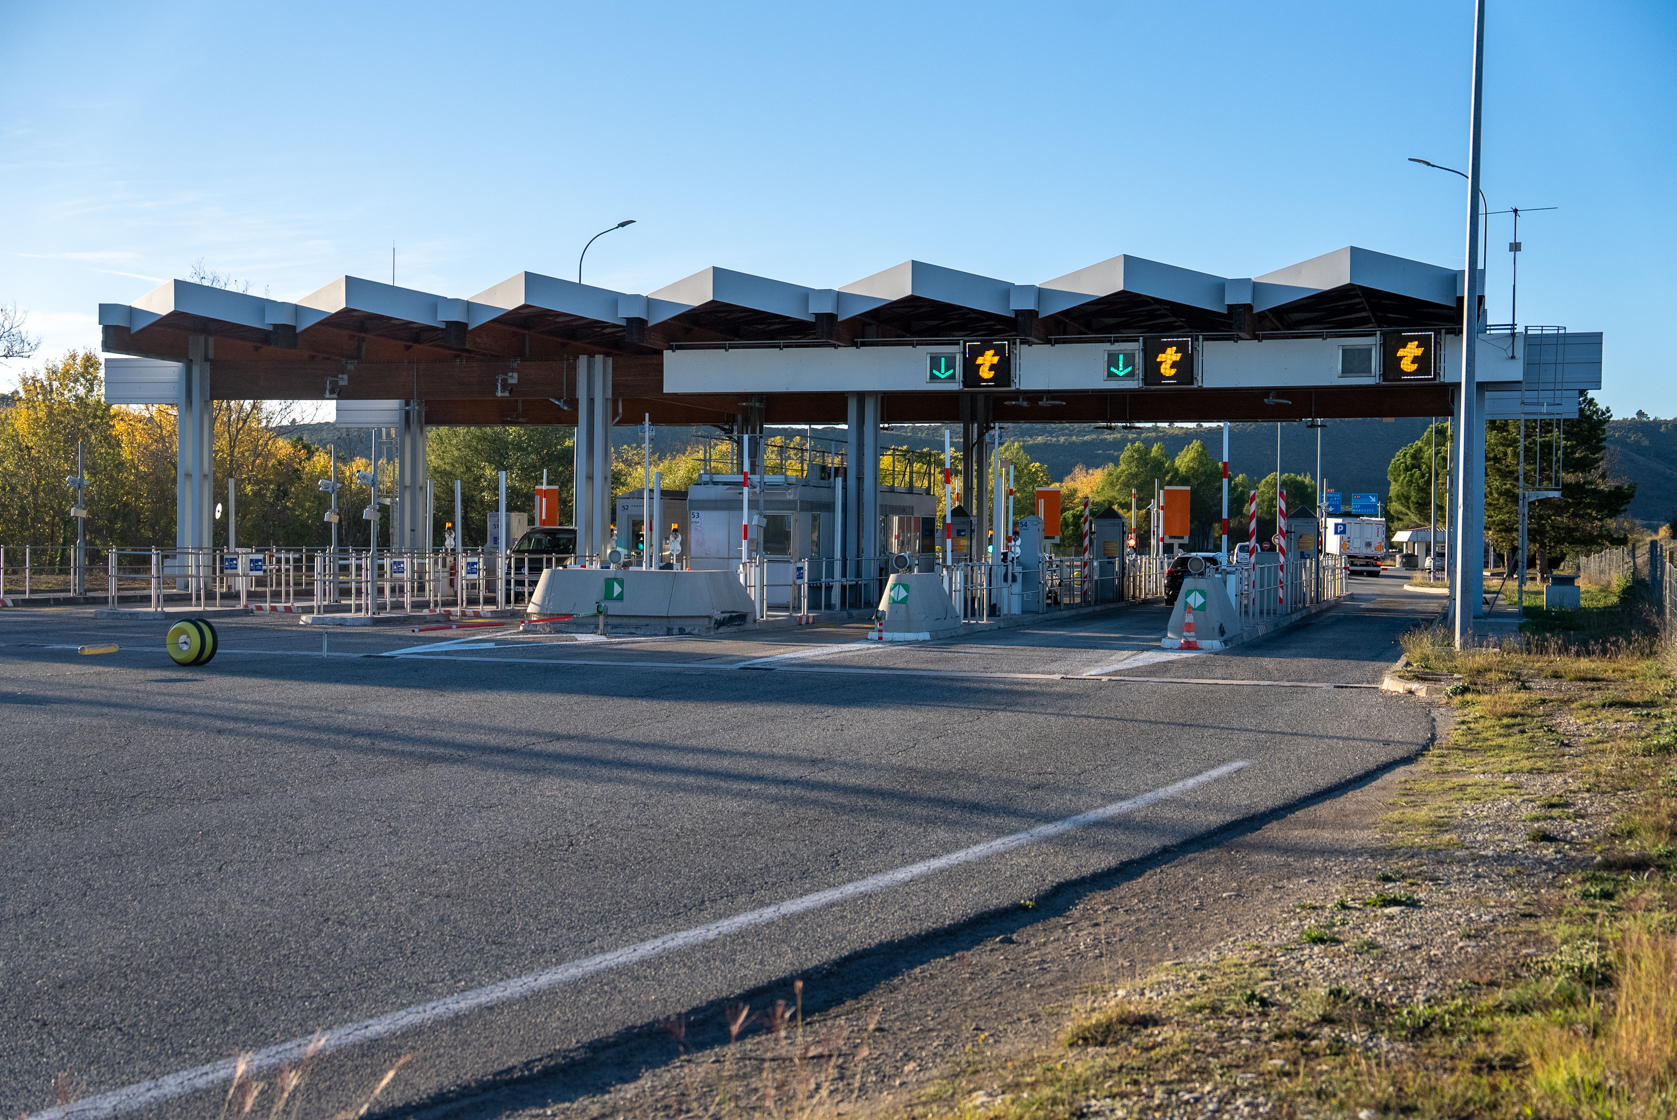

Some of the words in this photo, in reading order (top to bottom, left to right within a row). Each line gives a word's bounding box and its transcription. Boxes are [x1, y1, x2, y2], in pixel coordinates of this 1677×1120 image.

[975, 349, 1000, 380] t
[1156, 346, 1182, 377] t
[1396, 340, 1424, 373] t
[691, 511, 700, 519] 53
[1337, 525, 1344, 533] P
